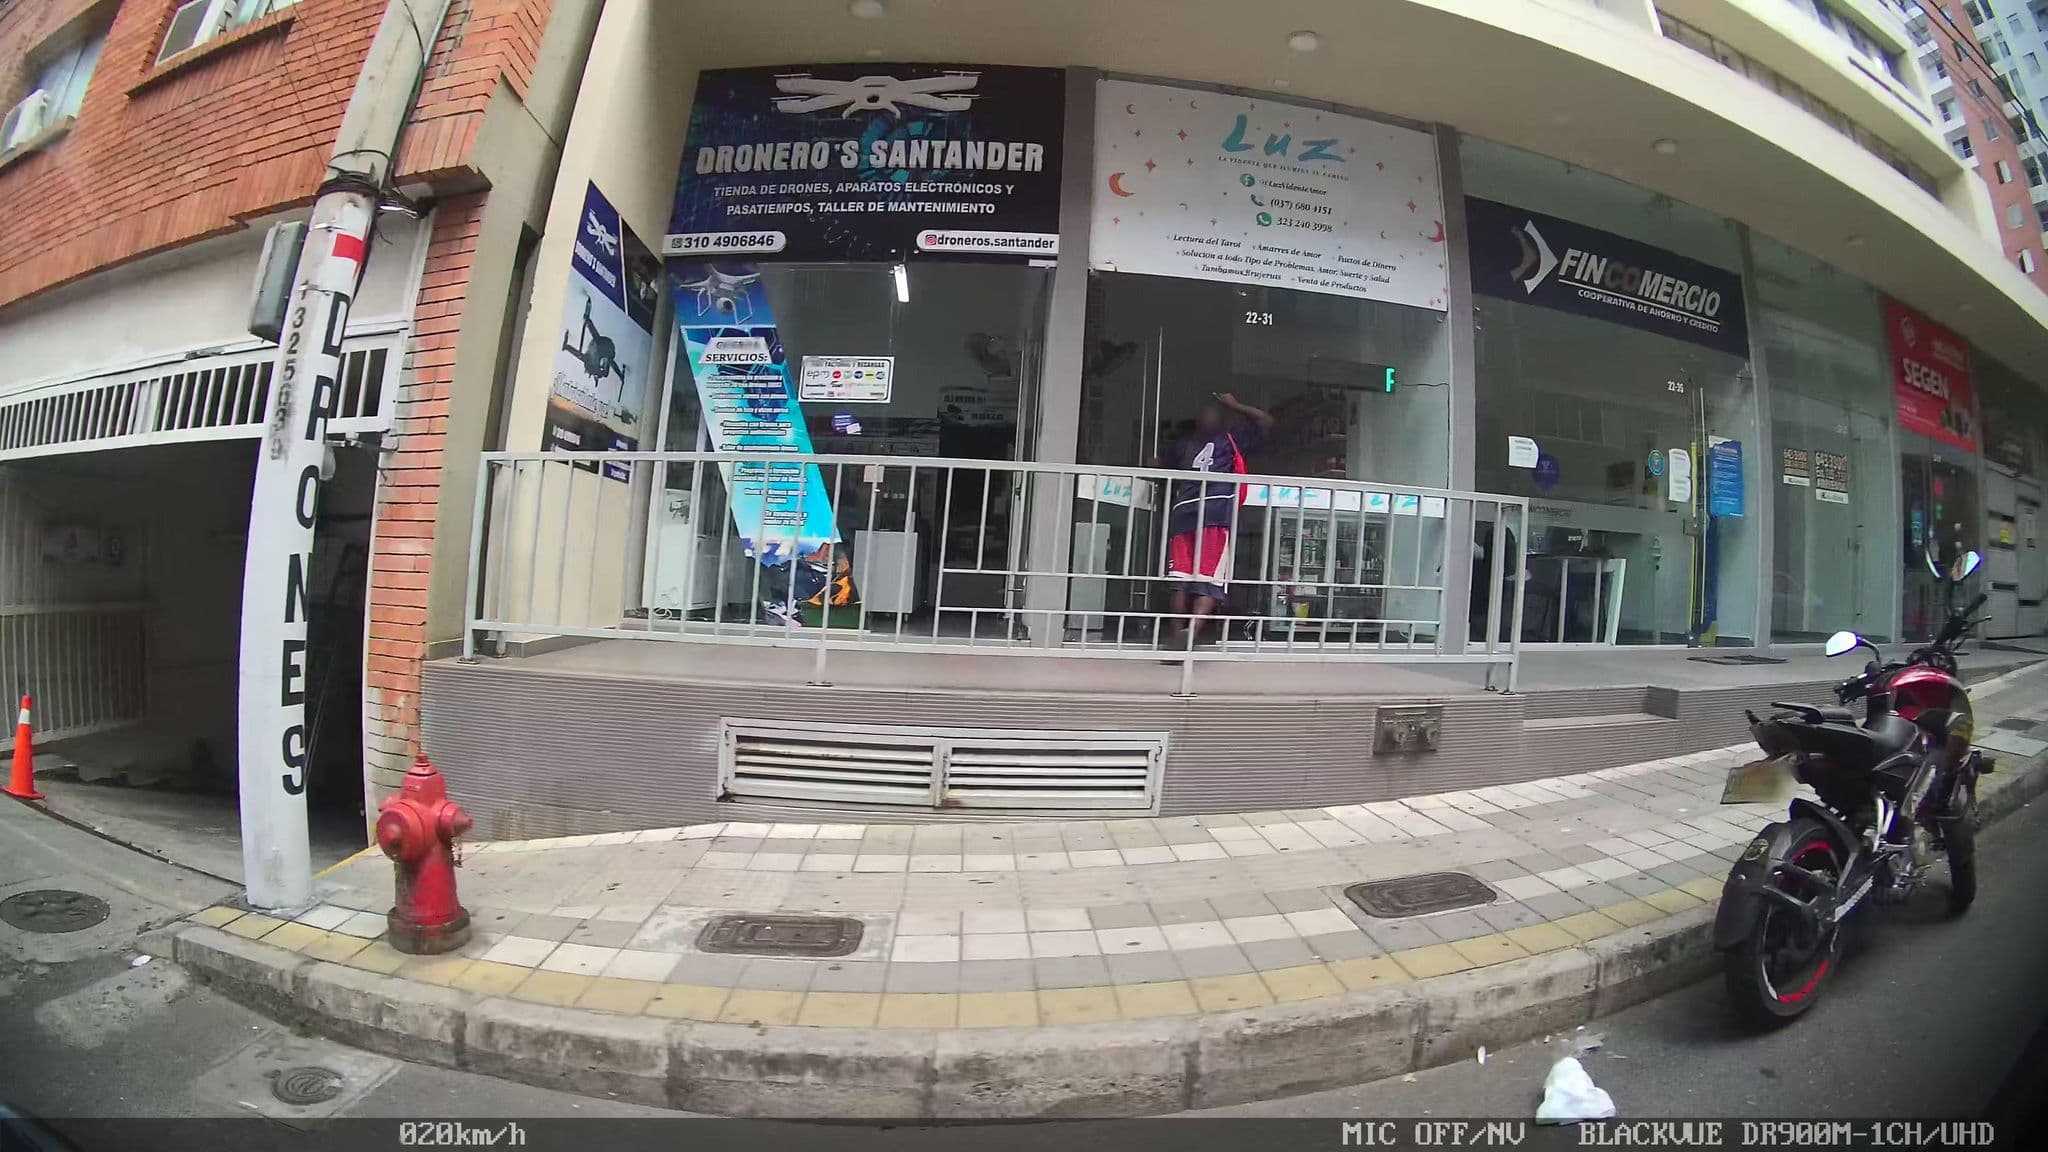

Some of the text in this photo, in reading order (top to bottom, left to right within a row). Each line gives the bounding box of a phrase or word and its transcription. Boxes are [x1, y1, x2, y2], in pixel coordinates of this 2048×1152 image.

[696, 140, 1044, 175] DRONERO'S SANTANDER
[714, 186, 757, 197] TIENDA
[759, 184, 777, 194] DE
[779, 182, 832, 195] DRONES,
[835, 182, 901, 193] APARATOS
[1005, 184, 1015, 195] Y
[727, 201, 996, 216] PASATIEMPOS, TALLER DE MANTENIMIENTO
[684, 235, 775, 248] 310 4906846
[938, 234, 1055, 249] droneros.santander
[1173, 234, 1242, 248] Lectura del Tarot
[1257, 244, 1322, 258] Amarres de Amor
[1244, 255, 1261, 265] Tipo
[1263, 257, 1273, 266] de
[1362, 258, 1371, 267] de
[1372, 261, 1397, 271] Dinero
[1320, 279, 1329, 287] de
[1558, 247, 1721, 317] FINCOMERCIO
[1578, 289, 1636, 311] COOPERATIVA
[1637, 304, 1649, 313] DE
[1649, 307, 1682, 322] AHORRO
[1246, 311, 1273, 325] 22-31
[705, 353, 768, 362] SERVICIOS:
[1903, 358, 1950, 400] SEGEN
[1192, 442, 1215, 472] 4
[281, 291, 351, 797] DRONES
